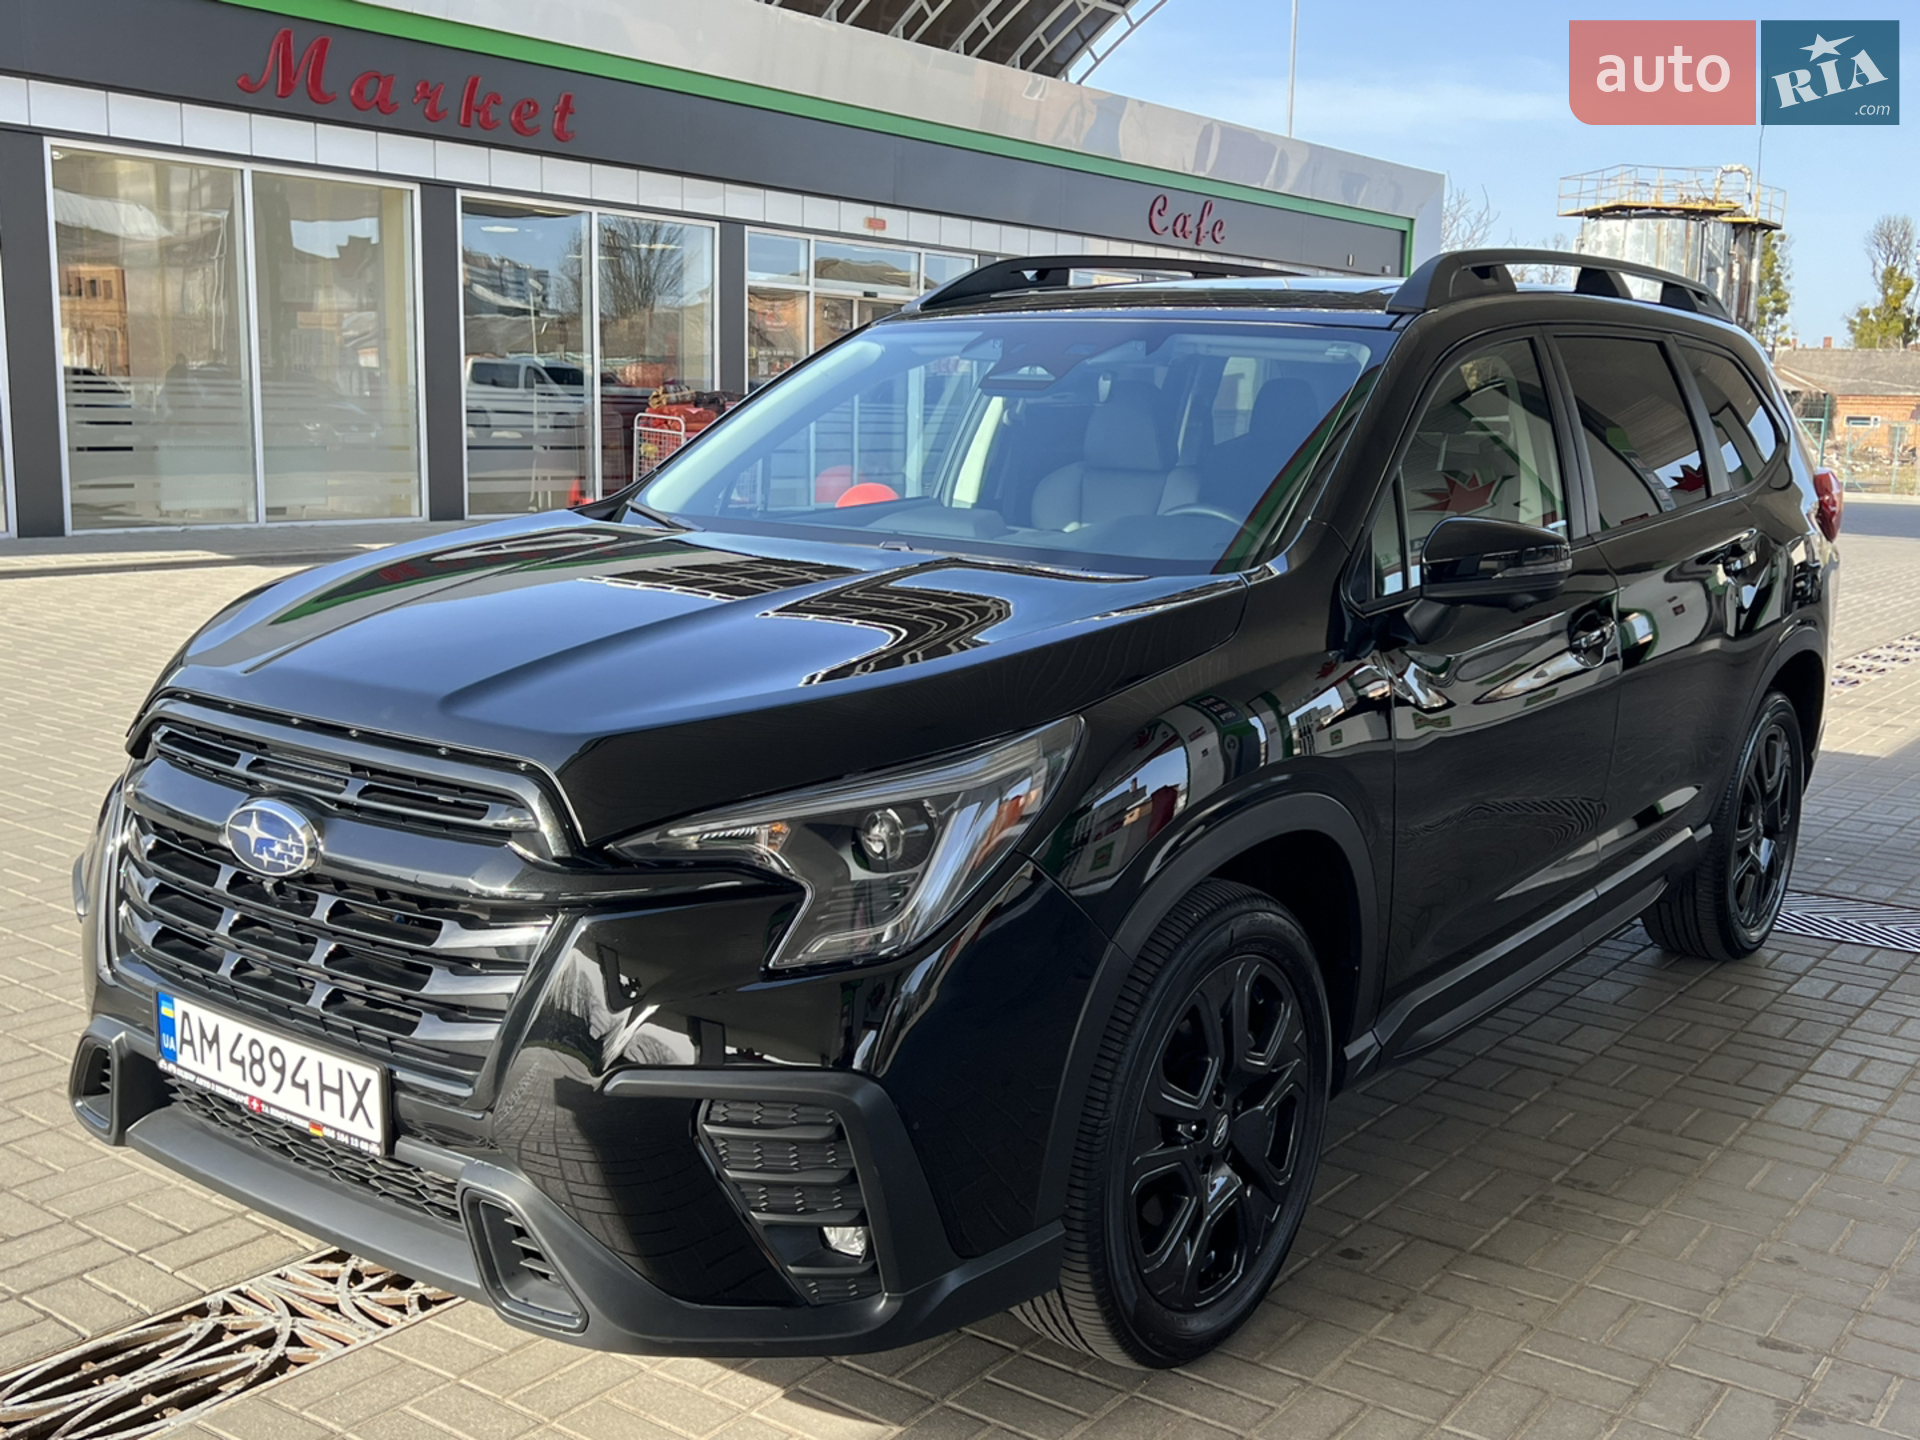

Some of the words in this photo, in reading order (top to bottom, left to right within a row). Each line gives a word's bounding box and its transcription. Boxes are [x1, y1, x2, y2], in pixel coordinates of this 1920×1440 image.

[236, 28, 576, 142] Market
[1148, 194, 1225, 246] Cafe
[162, 1033, 176, 1051] UA
[229, 1032, 311, 1107] 4894
